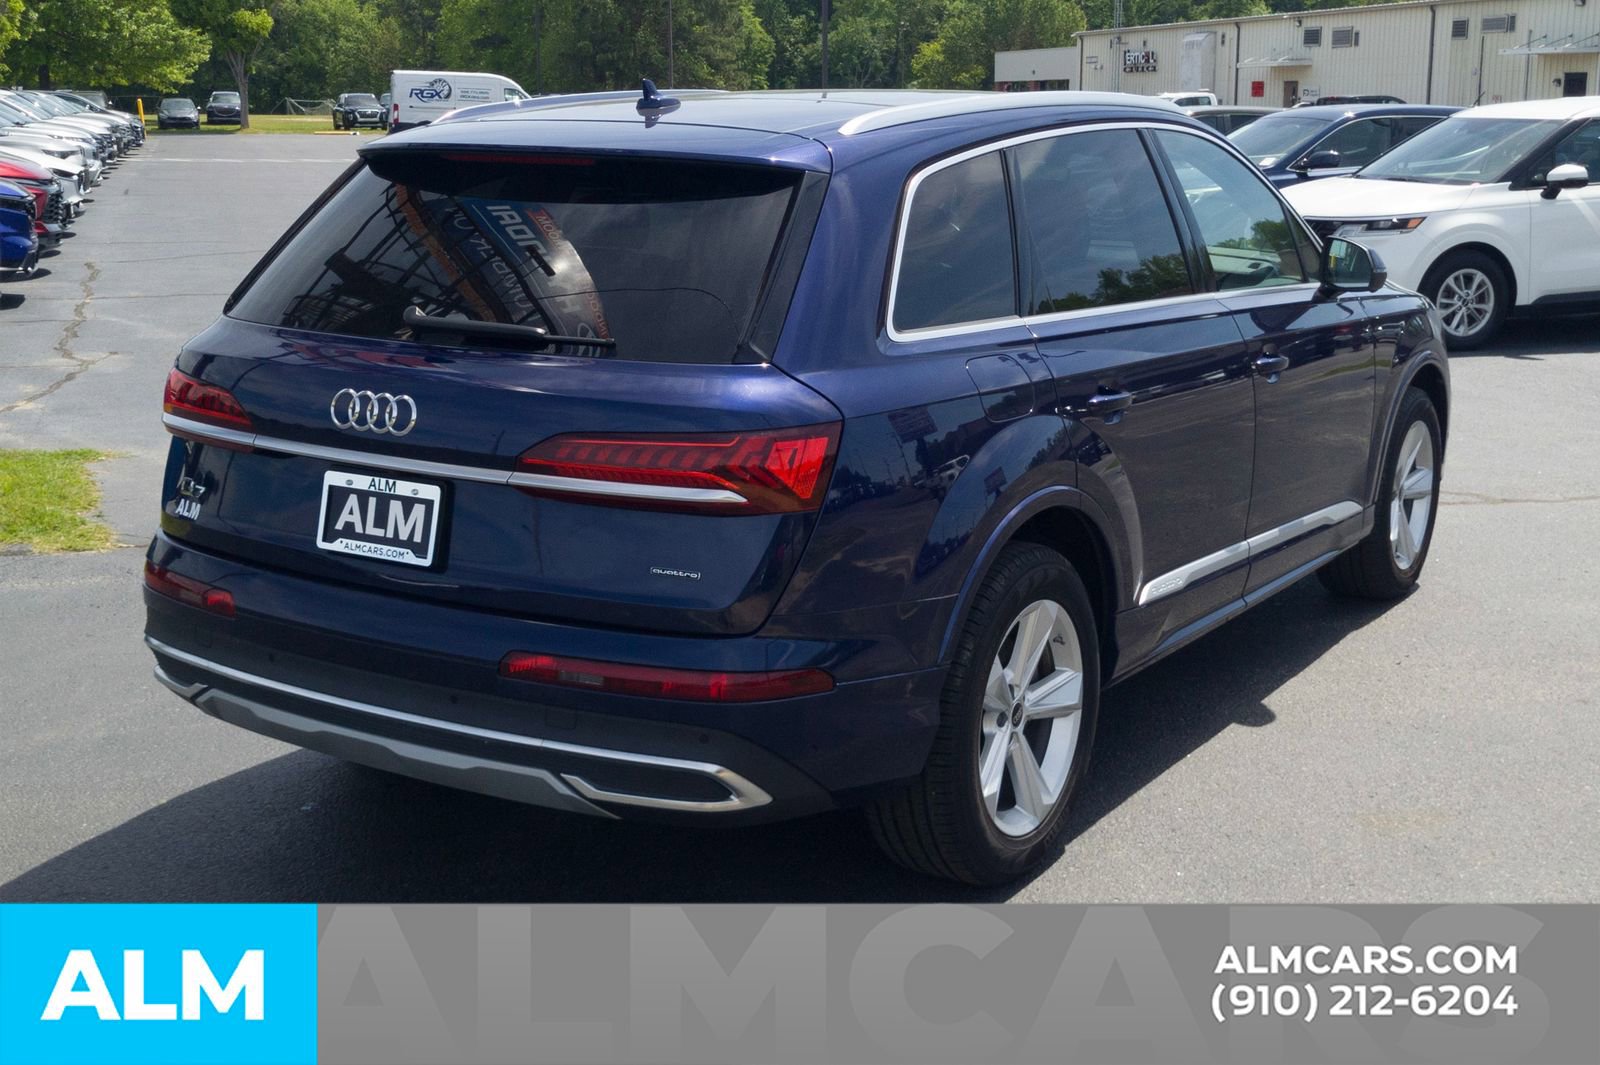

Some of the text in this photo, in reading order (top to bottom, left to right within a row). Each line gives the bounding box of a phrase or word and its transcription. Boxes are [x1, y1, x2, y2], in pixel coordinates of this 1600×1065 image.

[409, 88, 444, 103] RGX
[368, 477, 397, 493] ALM
[175, 498, 201, 520] ALM
[334, 493, 426, 543] ALM
[344, 542, 405, 559] ALMCARS.COM
[652, 568, 698, 579] quattro
